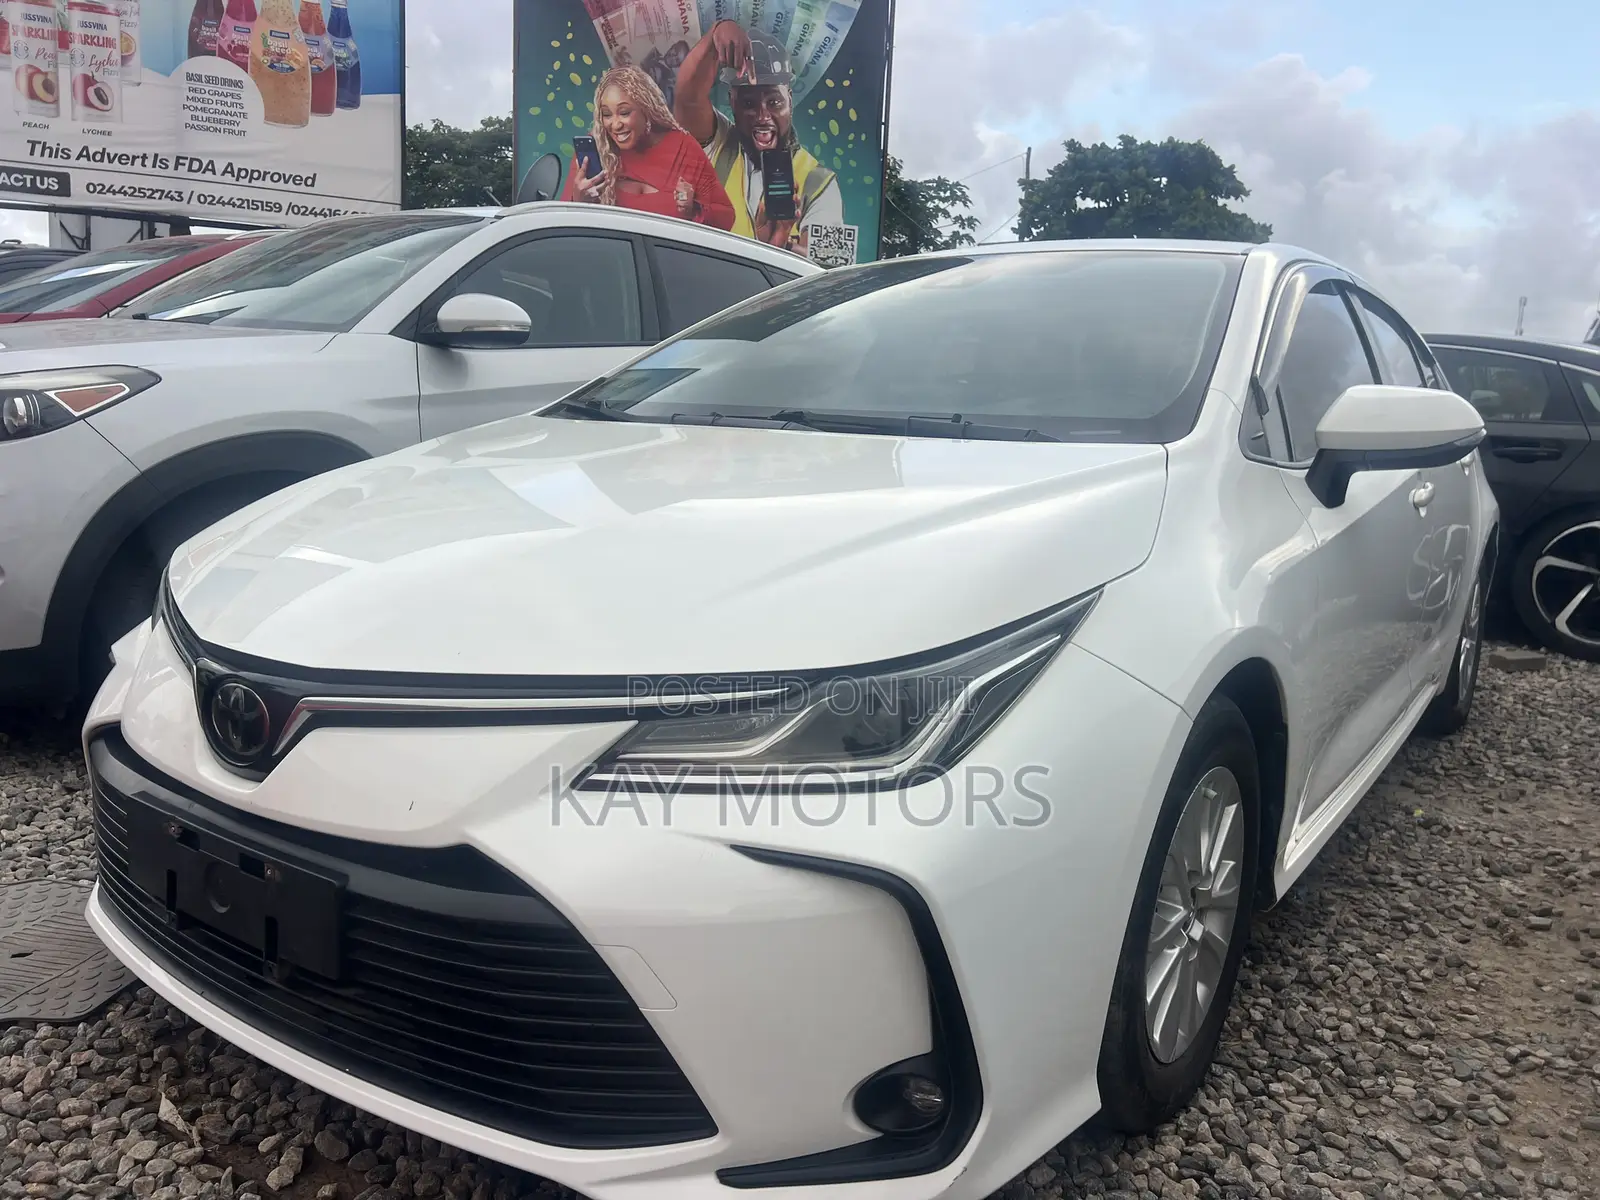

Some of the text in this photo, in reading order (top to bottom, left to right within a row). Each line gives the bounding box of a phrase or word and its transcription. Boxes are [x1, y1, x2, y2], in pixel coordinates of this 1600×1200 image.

[677, 0, 690, 35] HANA
[750, 0, 760, 27] HAN
[772, 12, 783, 37] GHA
[792, 23, 810, 57] GHANA
[809, 36, 831, 65] GHANA
[186, 72, 244, 90] BASIL SEED DRINKS
[186, 95, 245, 110] MIXED FRUITS
[188, 86, 242, 100] RED GRAPES
[182, 103, 248, 120] POMEGRANATE
[190, 114, 241, 127] BLUEBERRY
[22, 121, 50, 130] PEACH
[82, 127, 113, 137] LYCHEE
[184, 122, 247, 137] PASSION FRUIT
[26, 139, 318, 188] This Advert Is FDA Approved
[0, 171, 60, 191] ACT US
[85, 182, 185, 203] 0244252743
[196, 192, 284, 214] 0244215159
